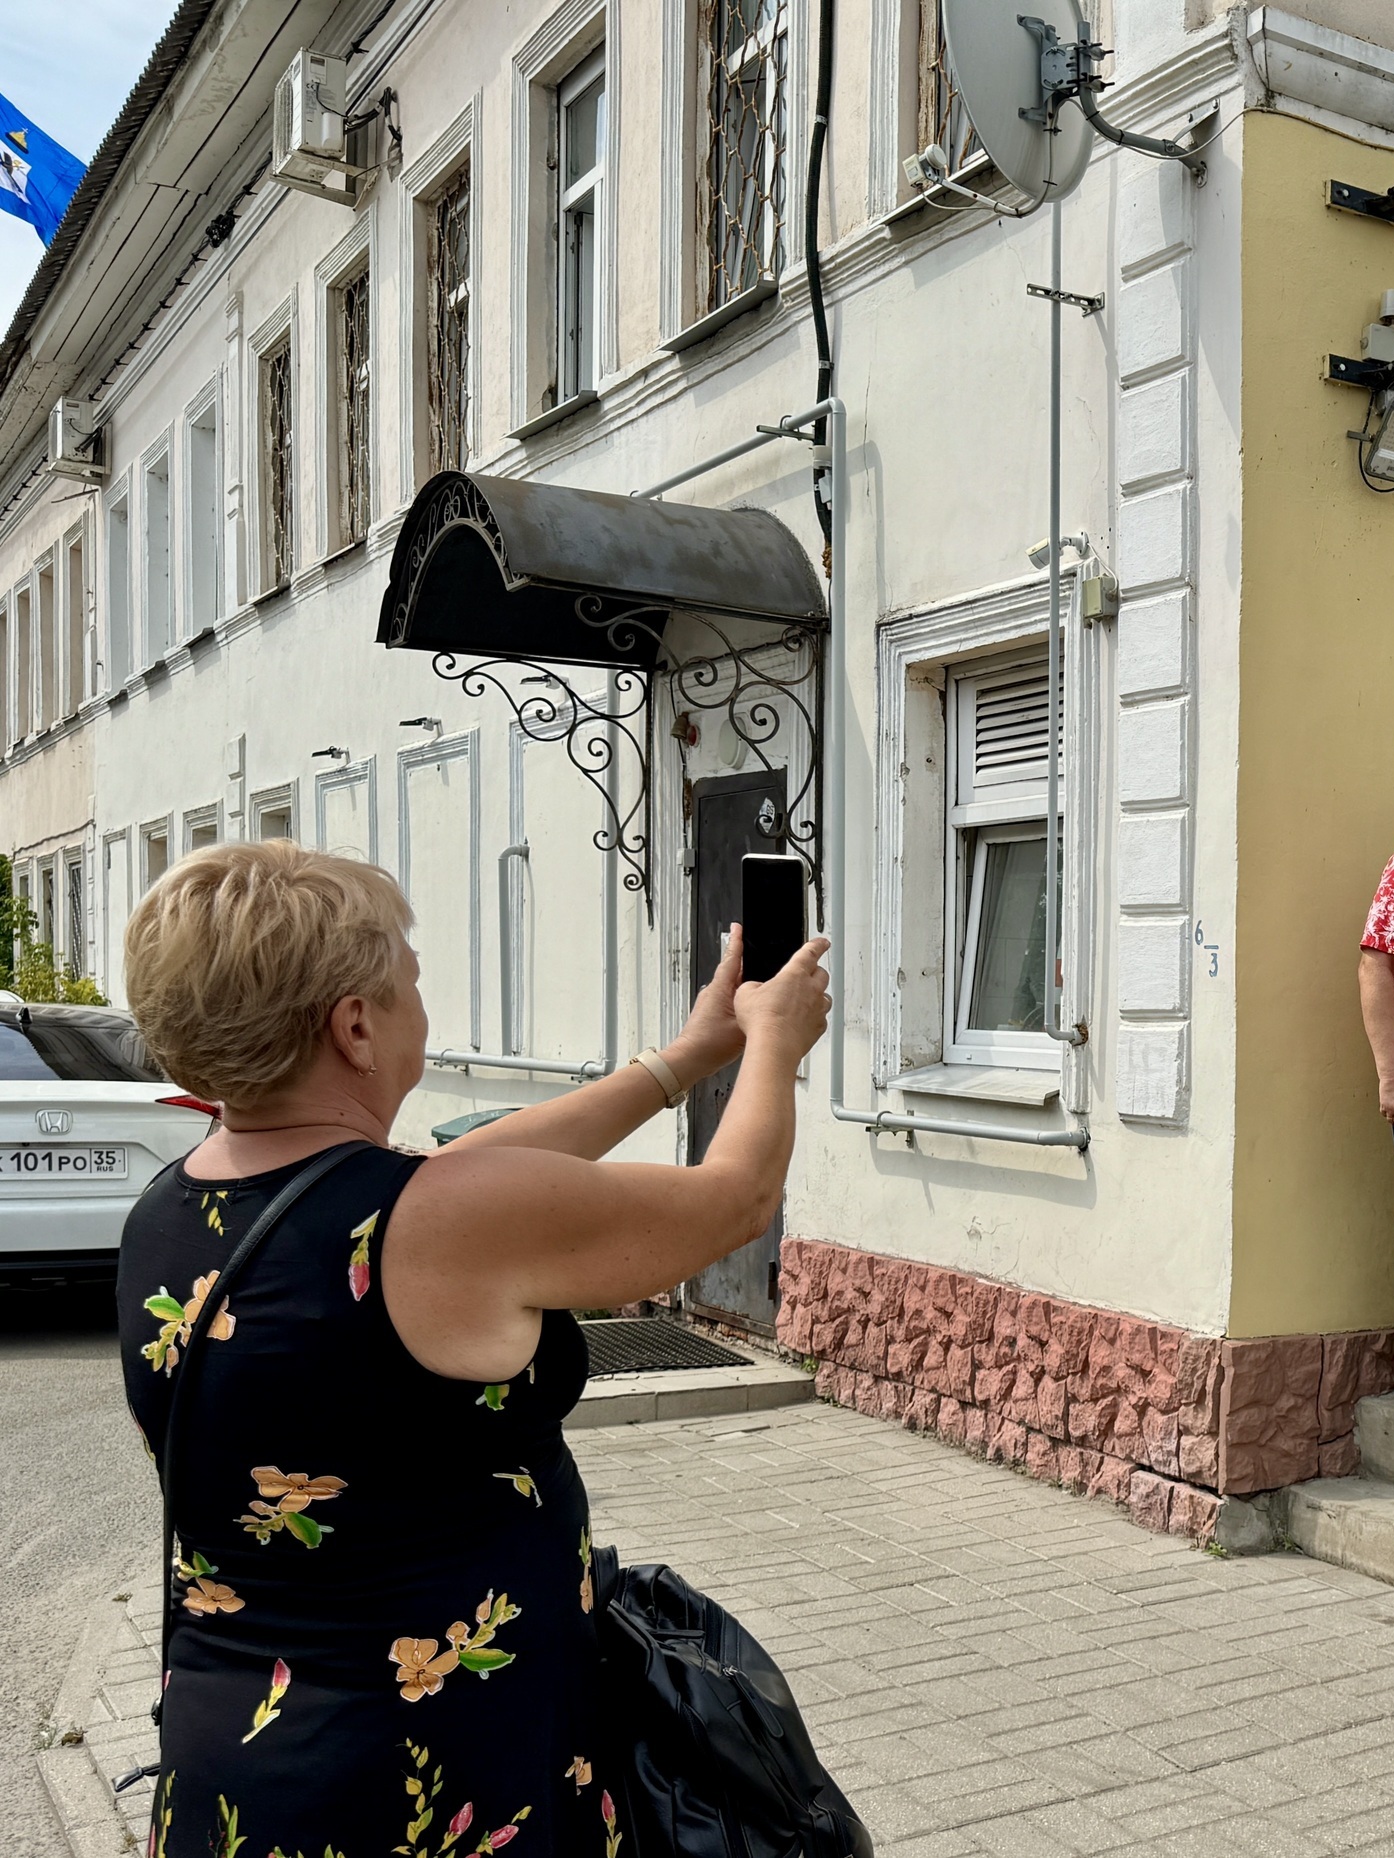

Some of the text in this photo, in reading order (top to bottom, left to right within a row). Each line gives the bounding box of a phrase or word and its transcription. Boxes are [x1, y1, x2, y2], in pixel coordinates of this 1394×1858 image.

[1195, 920, 1204, 946] 6
[1209, 953, 1219, 977] 3
[94, 1150, 116, 1165] 35
